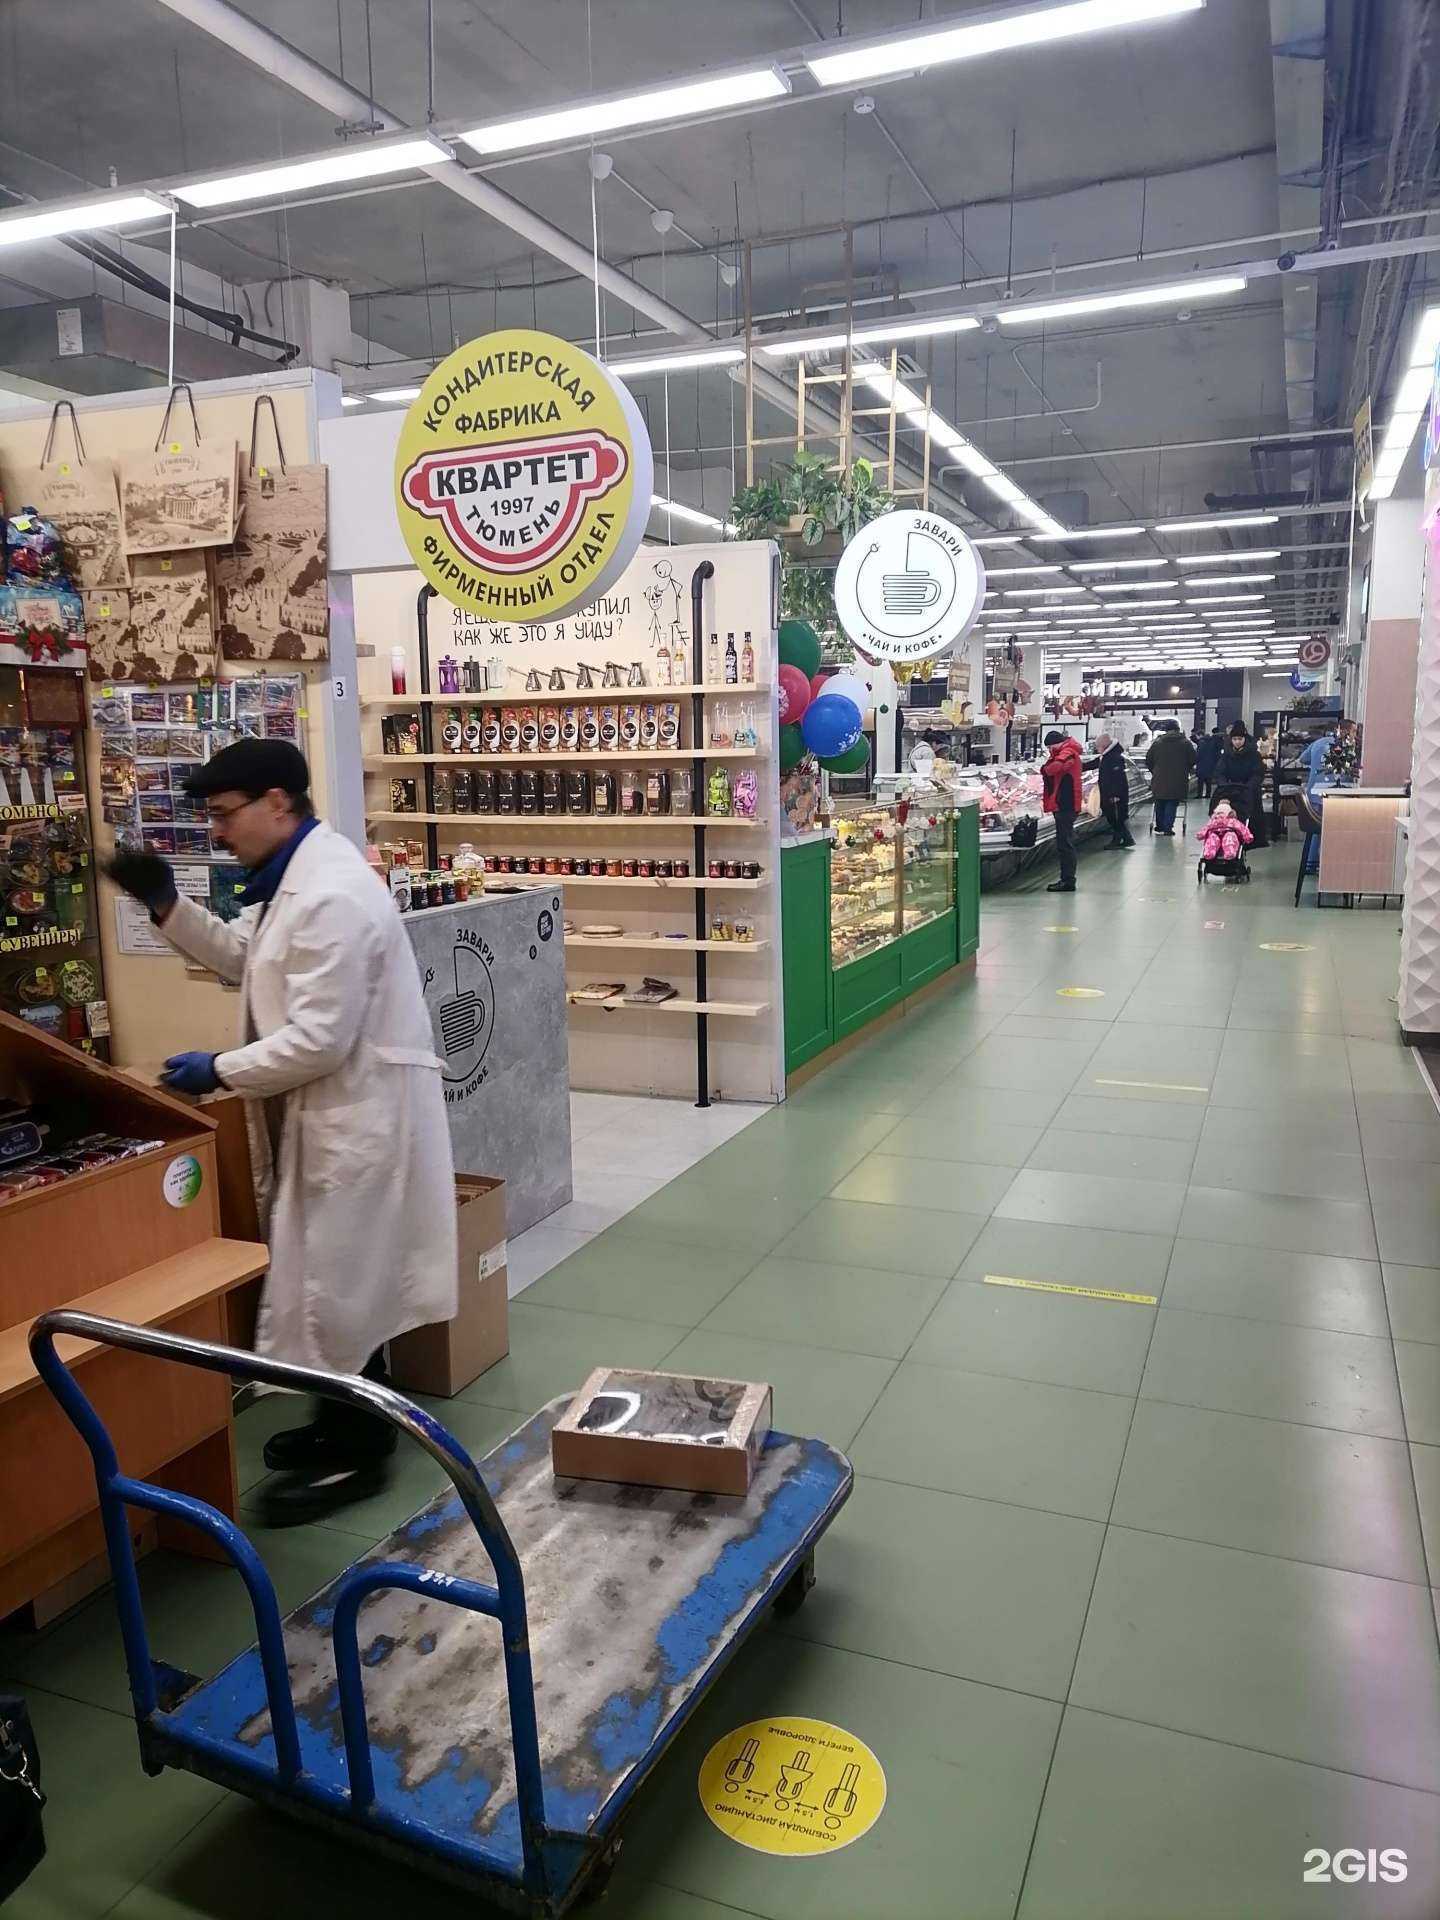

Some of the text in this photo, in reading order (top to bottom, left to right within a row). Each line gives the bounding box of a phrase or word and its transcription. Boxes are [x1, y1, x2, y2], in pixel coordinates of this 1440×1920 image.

[422, 351, 596, 432] КОНДИТЕРСКАЯ
[455, 400, 562, 434] ФАБРИКА
[436, 452, 590, 498] КВАРТЕТ
[465, 499, 561, 547] ТЮМЕНЬ
[490, 497, 534, 517] 1997
[913, 518, 963, 557] ЗАВАРИ
[423, 511, 615, 607] ФИРМЕННЫЙ ОТДЕЛ
[452, 607, 462, 625] Я
[454, 628, 482, 647] КАК
[490, 627, 513, 645] ЖЕ
[518, 624, 547, 643] ЭТО
[553, 623, 566, 641] Я
[893, 644, 901, 653] И
[905, 636, 938, 653] КОФЕ
[336, 681, 344, 697] 3
[1110, 680, 1149, 699] РЯД
[456, 928, 495, 967] ЗАВАРИ
[457, 1088, 464, 1102] И
[465, 1065, 489, 1097] КОФЕ
[767, 1726, 855, 1753] БЕРЕГИ ЗДОРОВЬЕ
[714, 1803, 837, 1842] СОБЛЮДАЙ ДИСТАНЦИЮ
